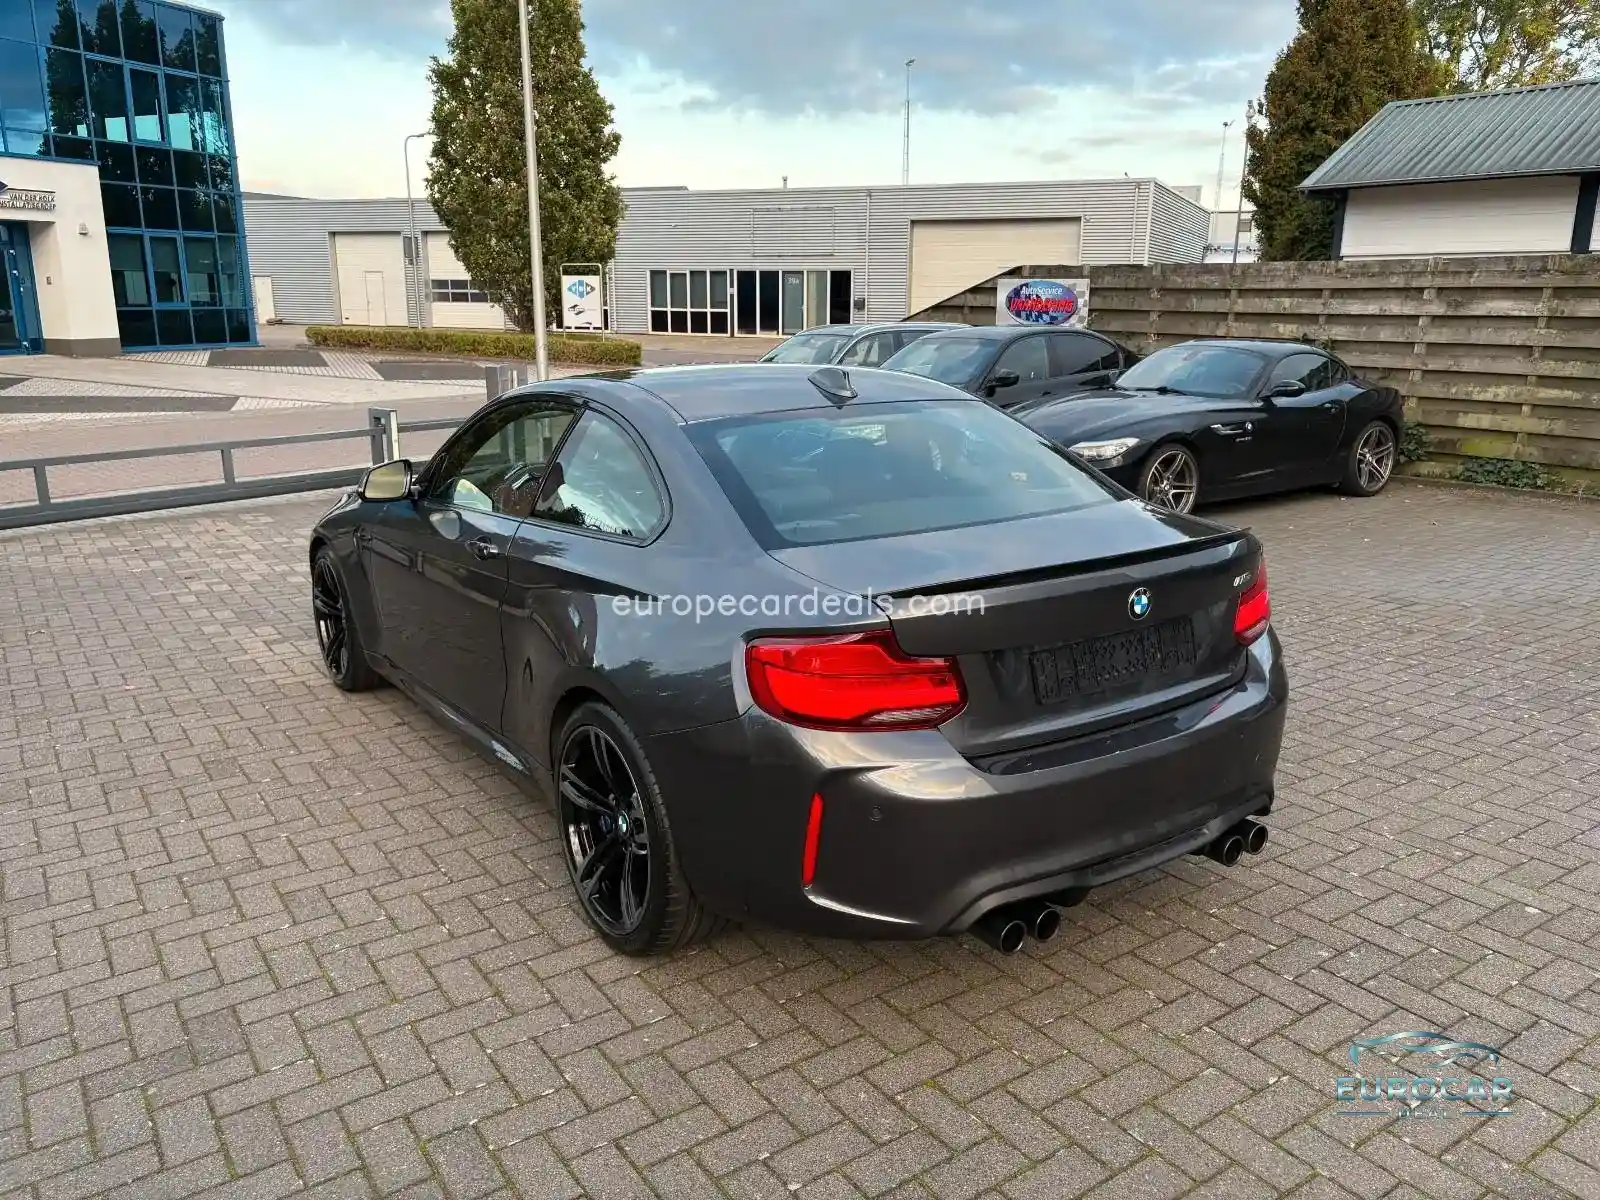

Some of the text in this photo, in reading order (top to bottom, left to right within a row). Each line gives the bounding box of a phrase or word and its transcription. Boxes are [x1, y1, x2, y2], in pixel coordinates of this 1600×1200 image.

[9, 193, 23, 201] VAN
[25, 194, 37, 202] DER
[1021, 286, 1063, 295] AutoService
